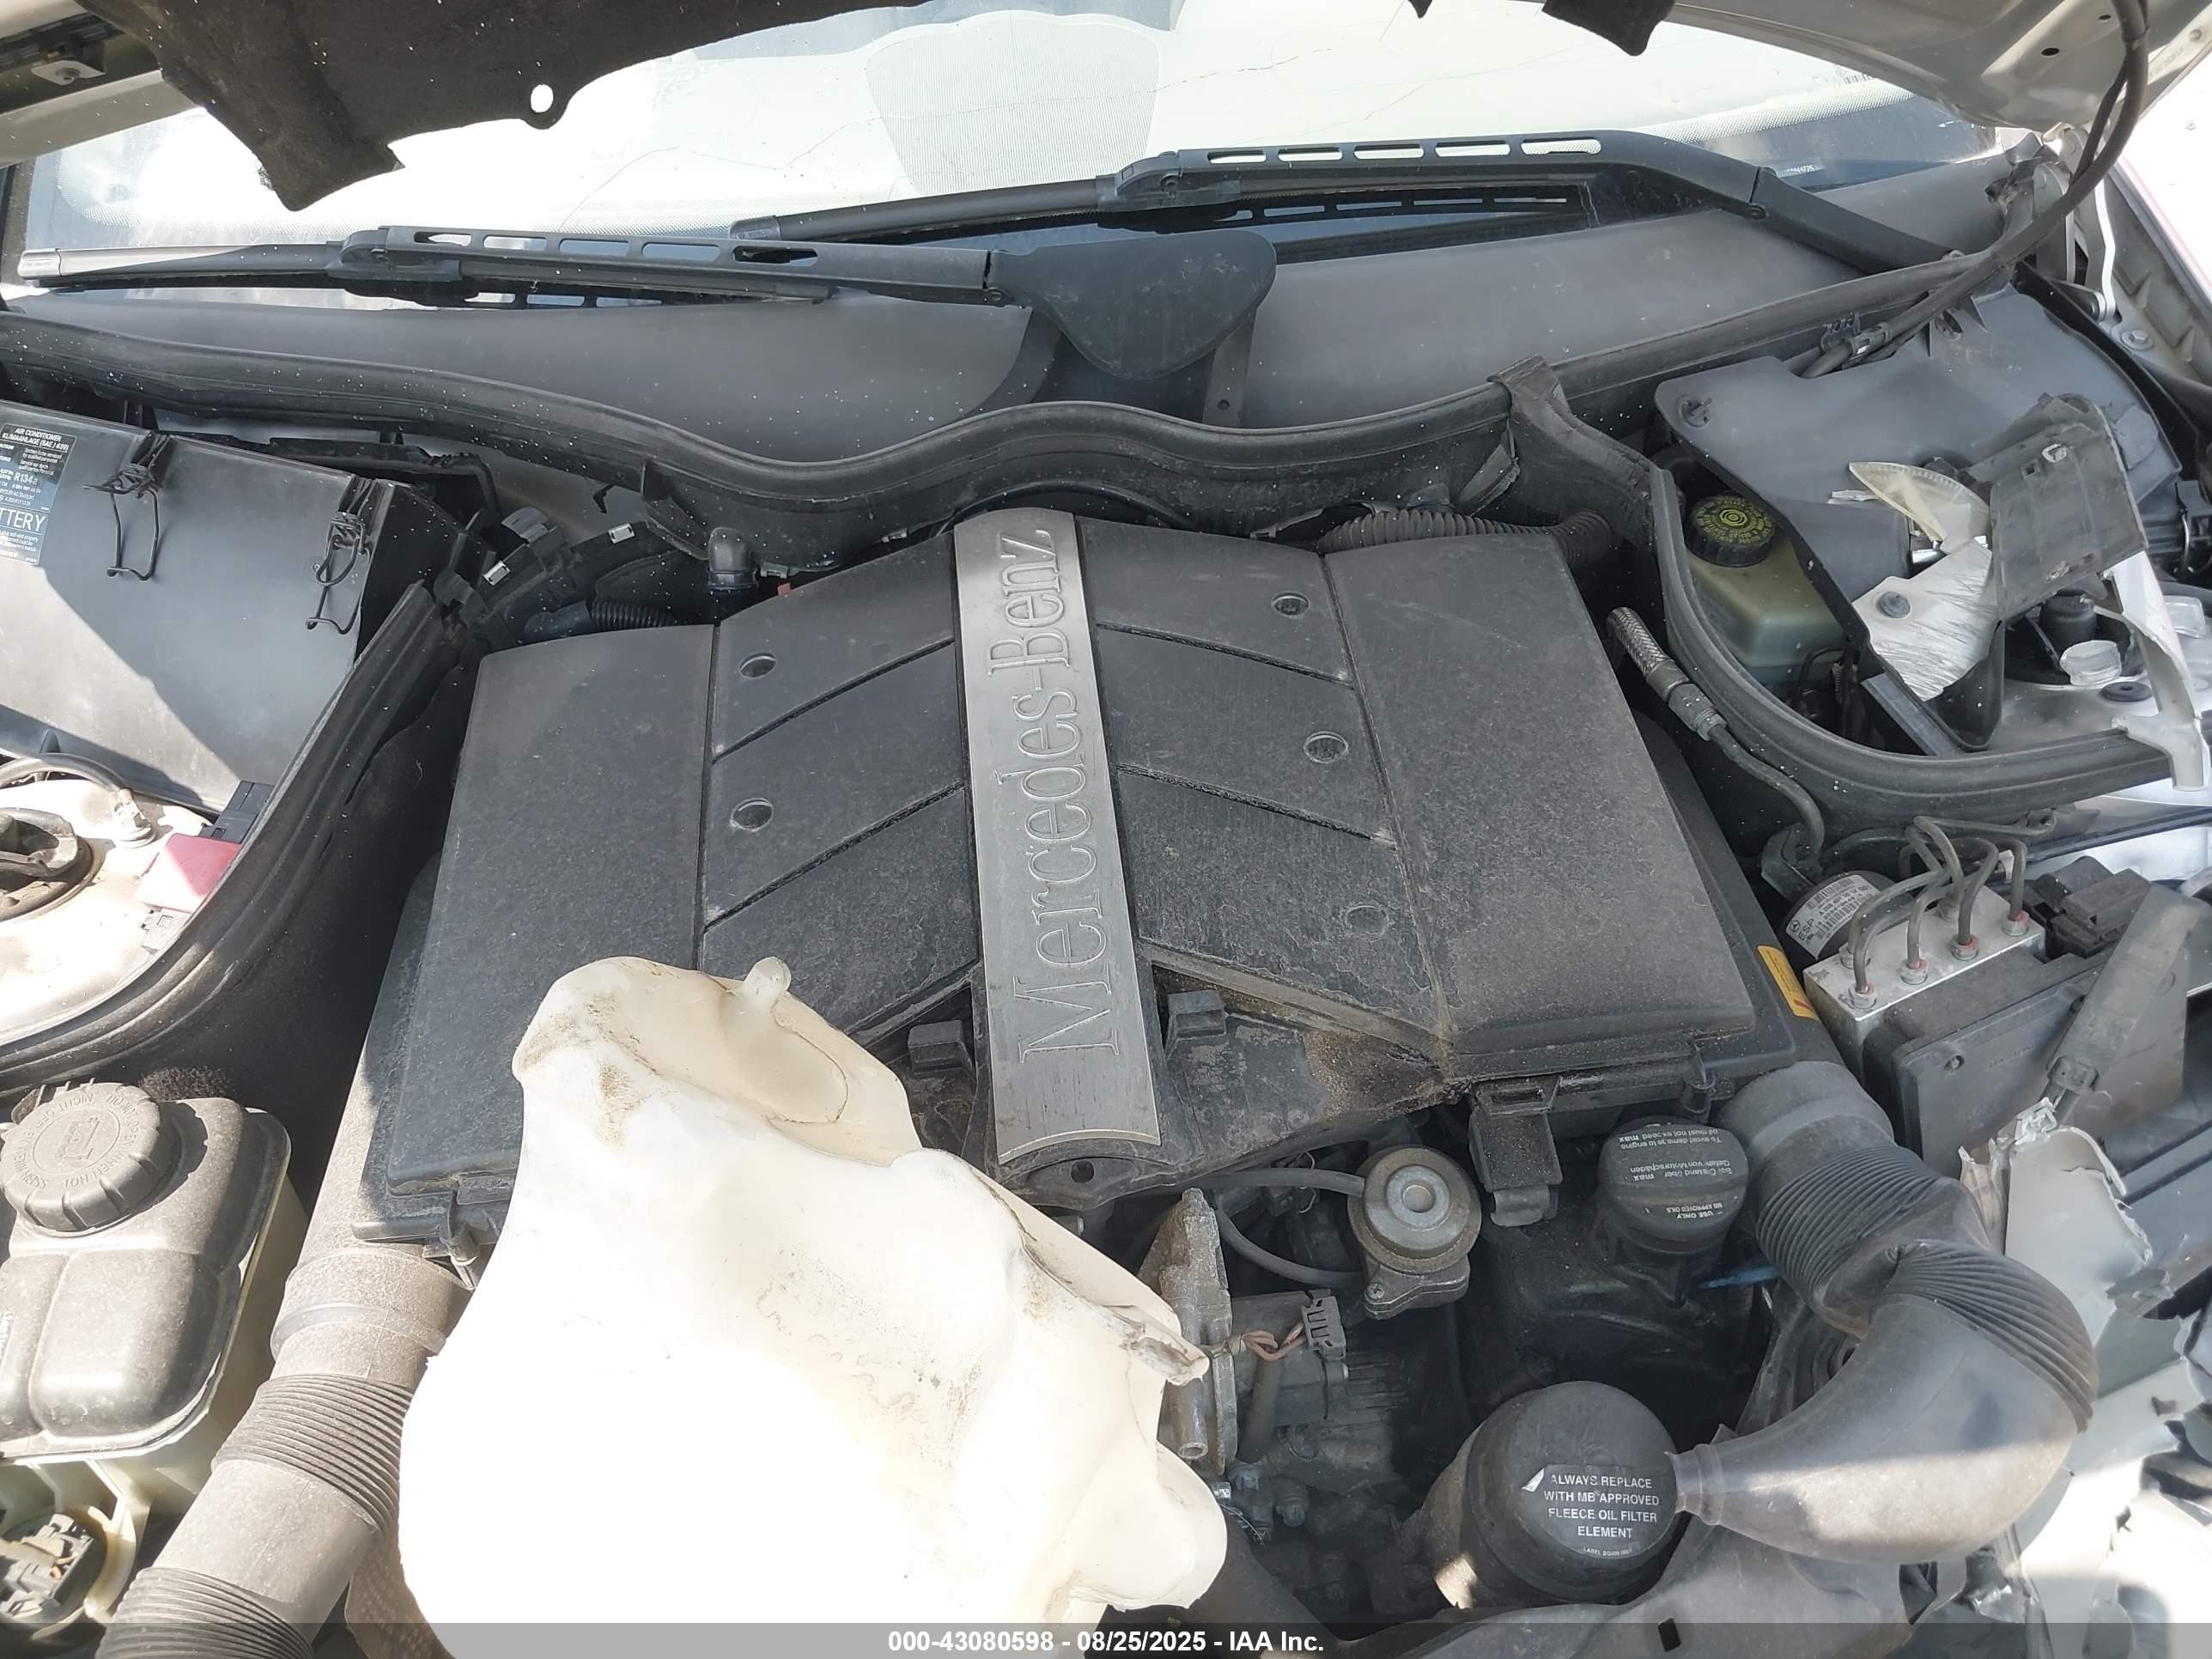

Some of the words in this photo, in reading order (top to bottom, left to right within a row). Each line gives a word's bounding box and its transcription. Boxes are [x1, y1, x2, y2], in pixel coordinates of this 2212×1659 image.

[25, 428, 62, 442] CONDITIONER
[14, 471, 39, 485] R134a
[988, 528, 1120, 1063] Mercedes-Benz
[1798, 918, 1814, 941] ESP
[1618, 1134, 1639, 1143] max
[1642, 1131, 1673, 1139] exceed
[1633, 1173, 1655, 1182] max
[1681, 1203, 1712, 1212] APPROVED
[1697, 1210, 1714, 1218] USE
[1551, 1474, 1597, 1486] ALWAYS
[1601, 1475, 1653, 1489] REPLACE
[1544, 1491, 1574, 1503] WITH
[1577, 1492, 1595, 1503] MB
[1599, 1492, 1659, 1506] APPROVED
[1548, 1507, 1595, 1521] FLEECE
[1598, 1509, 1618, 1521] OIL
[1620, 1510, 1657, 1523] FILTER
[1577, 1525, 1633, 1539] ELEMENT
